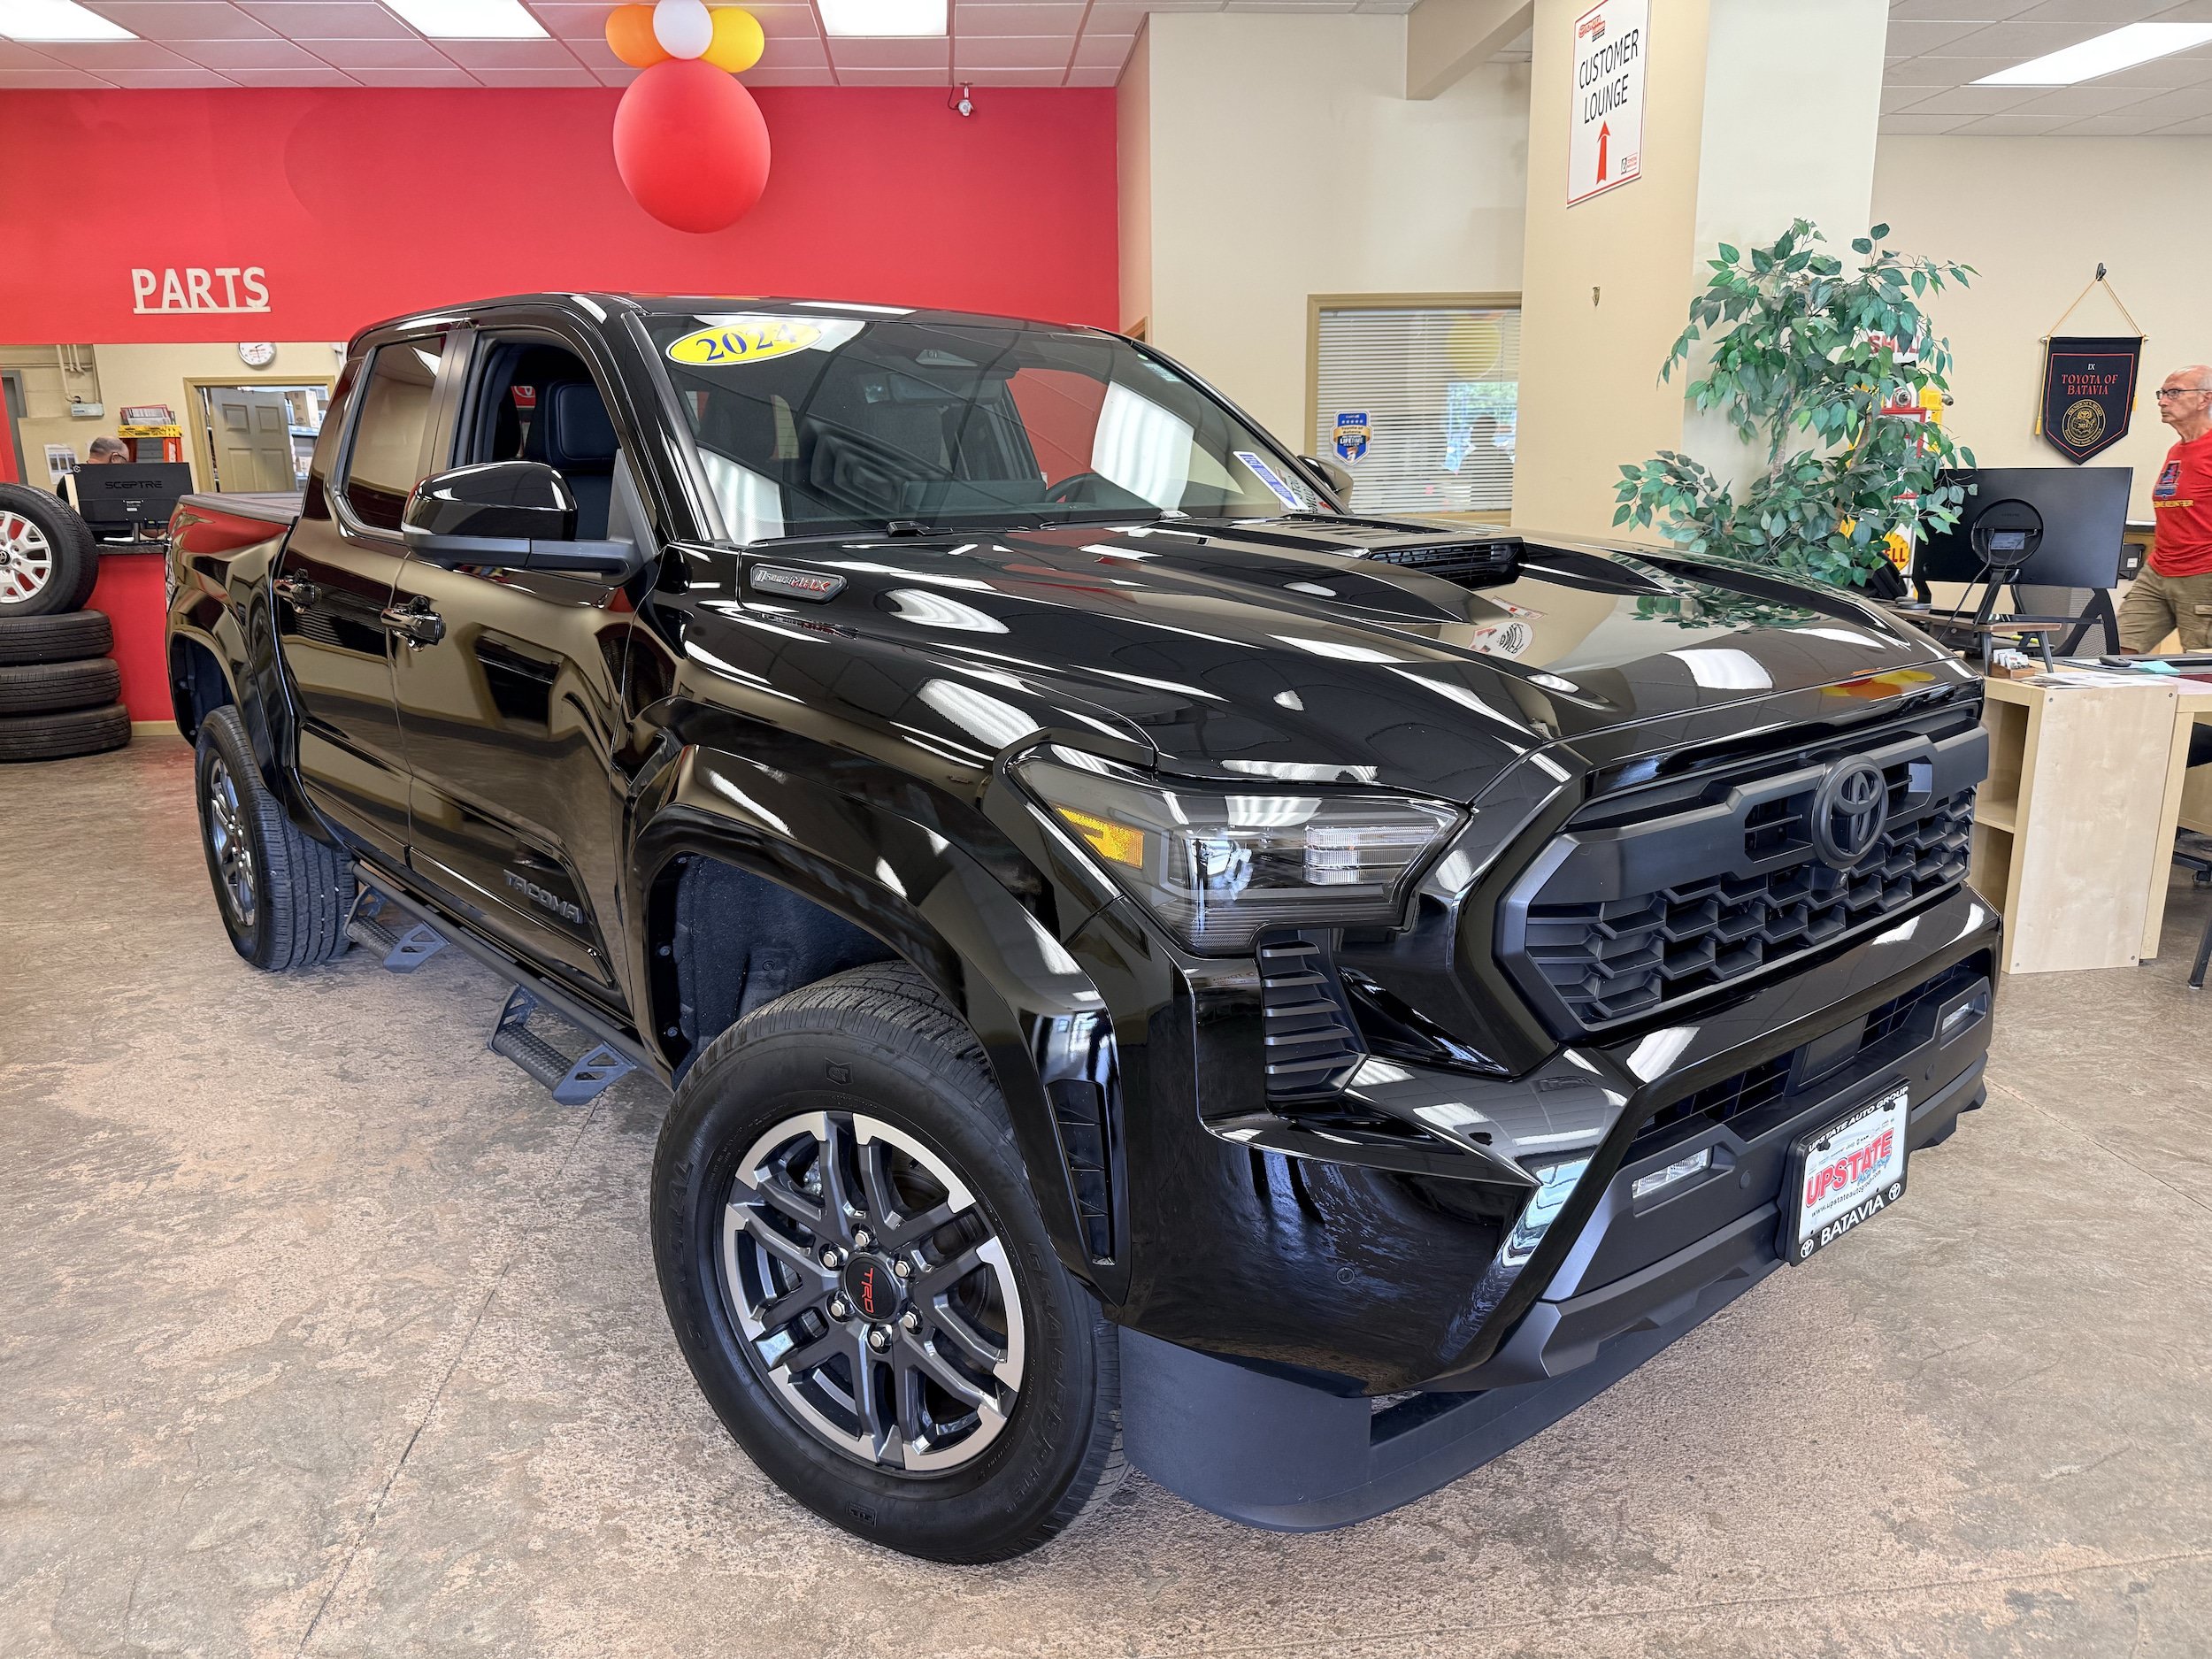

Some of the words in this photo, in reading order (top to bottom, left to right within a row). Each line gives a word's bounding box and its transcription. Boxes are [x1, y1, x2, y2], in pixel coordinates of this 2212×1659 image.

[1578, 28, 1640, 89] CUSTOMER
[1584, 73, 1630, 125] LOUNGE
[131, 266, 270, 311] PARTS
[2062, 374, 2101, 384] TOYOTA
[2104, 374, 2119, 384] OF
[2067, 385, 2108, 396] BATAVIA
[105, 480, 163, 489] SCEPTRE
[503, 869, 583, 925] TACOMA
[1808, 1120, 1847, 1153] UPSTATE
[1847, 1107, 1876, 1126] AUTO
[1876, 1086, 1909, 1110] GROUP
[1805, 1127, 1894, 1209] UPSTATE
[1820, 1195, 1885, 1247] BATAVIA
[861, 1267, 874, 1314] TRD
